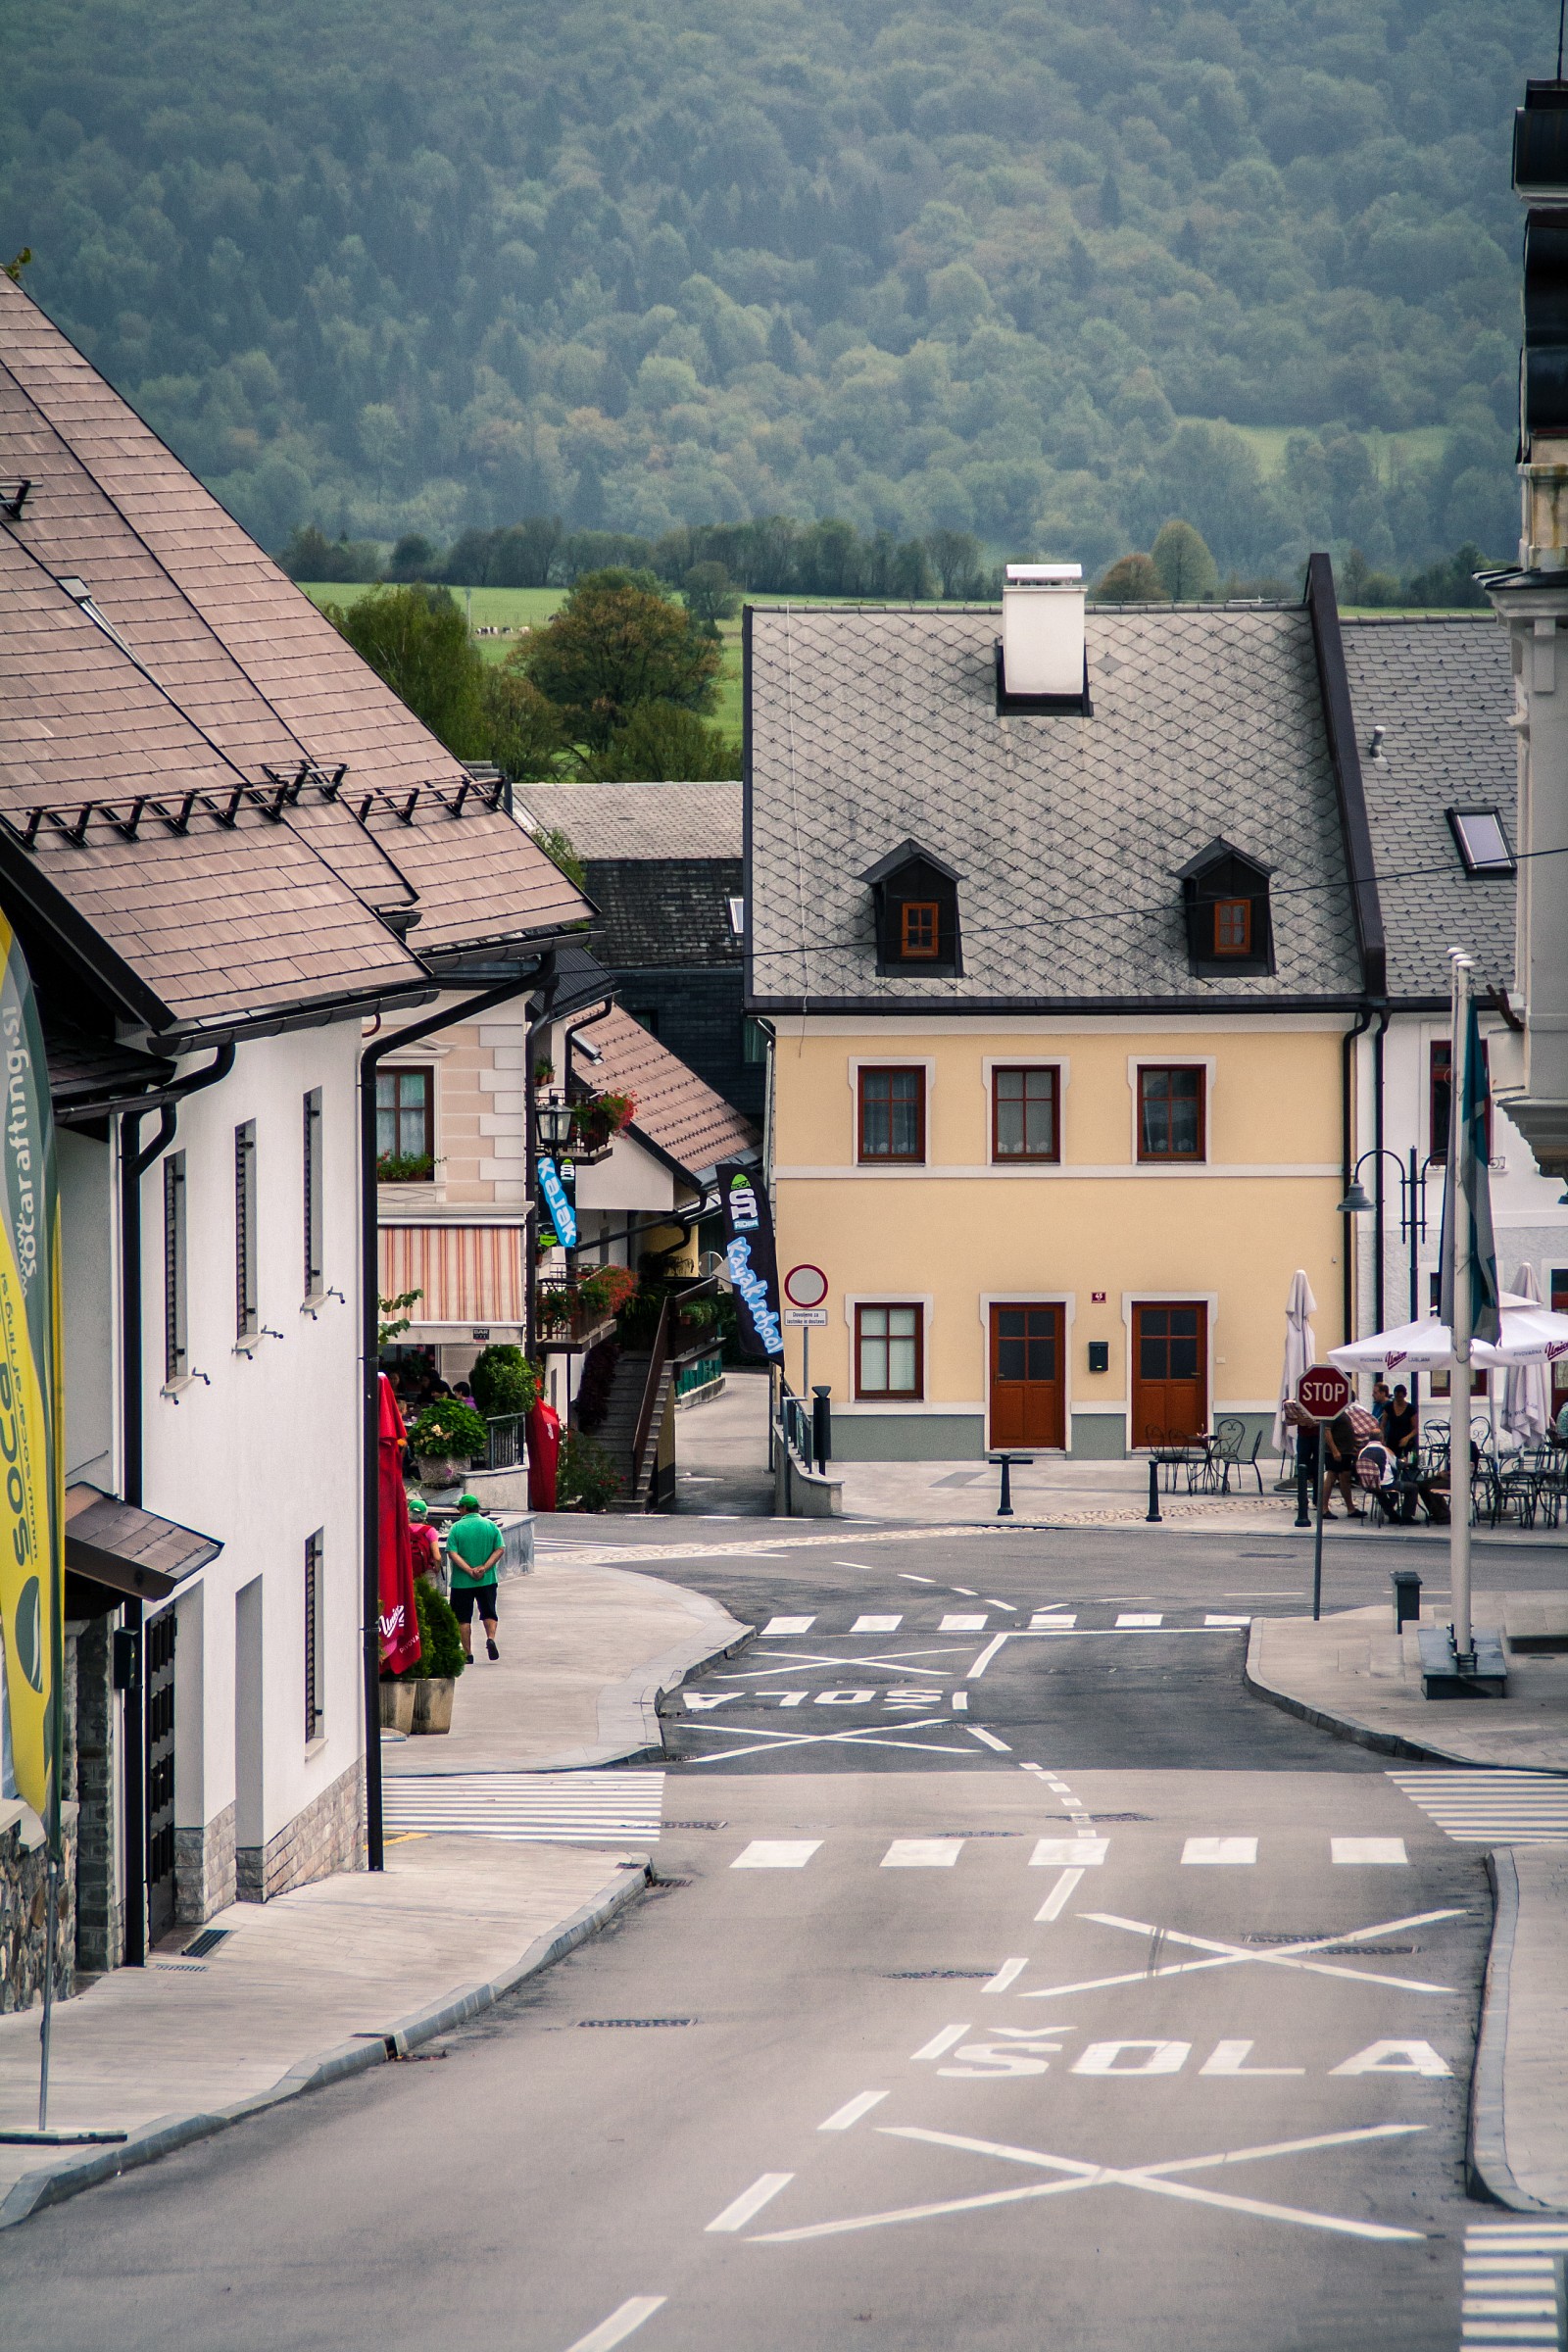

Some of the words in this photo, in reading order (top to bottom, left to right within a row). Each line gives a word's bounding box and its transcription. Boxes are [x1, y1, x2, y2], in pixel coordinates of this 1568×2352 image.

[749, 1300, 784, 1353] school
[1384, 1350, 1407, 1370] Union
[1513, 1348, 1543, 1357] PIVOVARNA
[1301, 1381, 1346, 1402] STOP
[682, 1690, 944, 1710] ŠOLA
[937, 2025, 1454, 2077] ŠOLA
